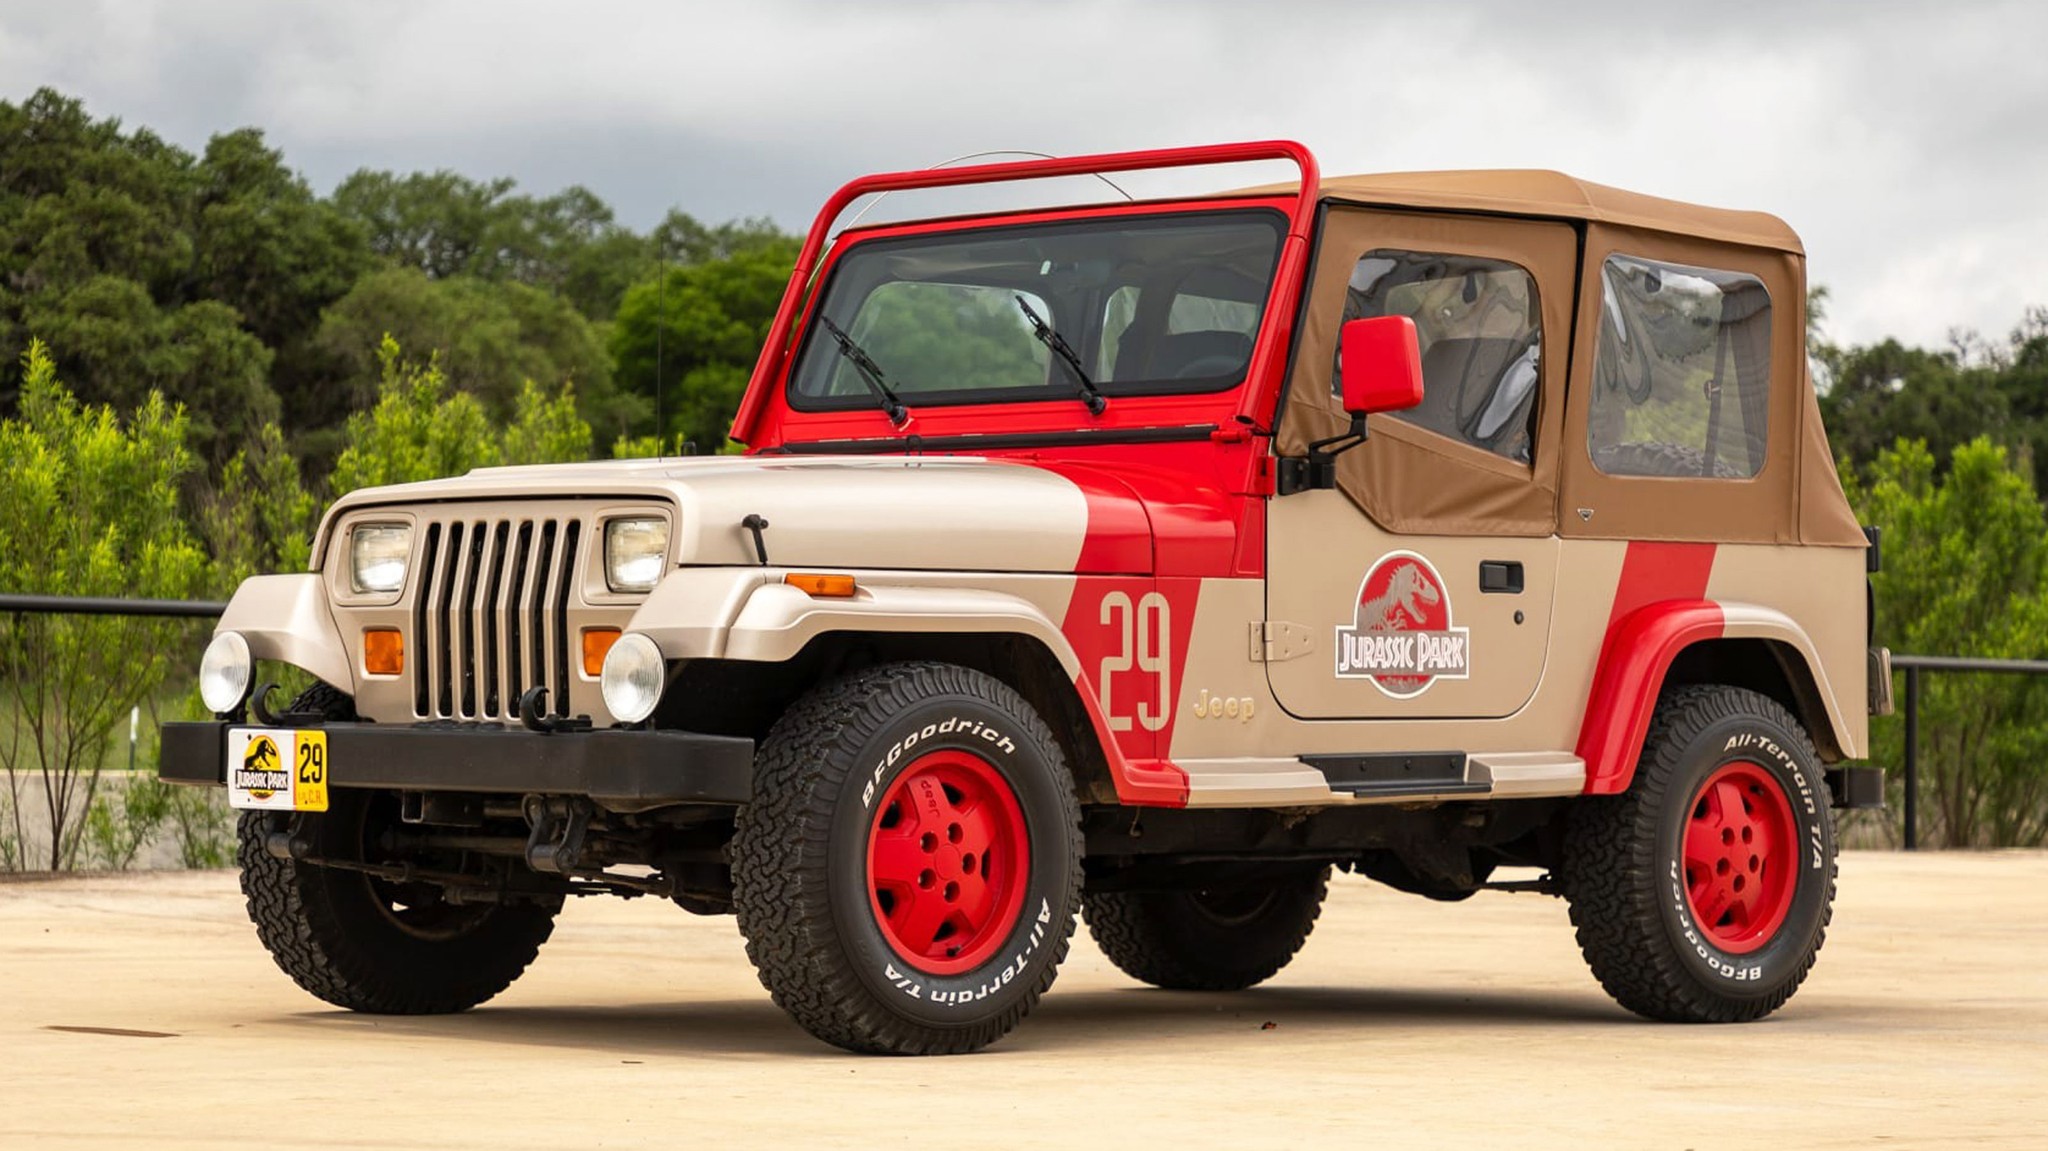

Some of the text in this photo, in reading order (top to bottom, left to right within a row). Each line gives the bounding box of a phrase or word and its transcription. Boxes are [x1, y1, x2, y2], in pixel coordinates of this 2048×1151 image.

[1100, 591, 1170, 731] 29
[1339, 632, 1464, 672] JURASSIC PARK
[1193, 689, 1254, 724] Jeep
[299, 743, 322, 783] 29
[862, 717, 1016, 808] BFGoodrich
[1724, 734, 1822, 869] All-Terrain T/A
[884, 897, 1051, 1007] All-Terrain T/A
[1670, 860, 1762, 980] BFGoodrich
